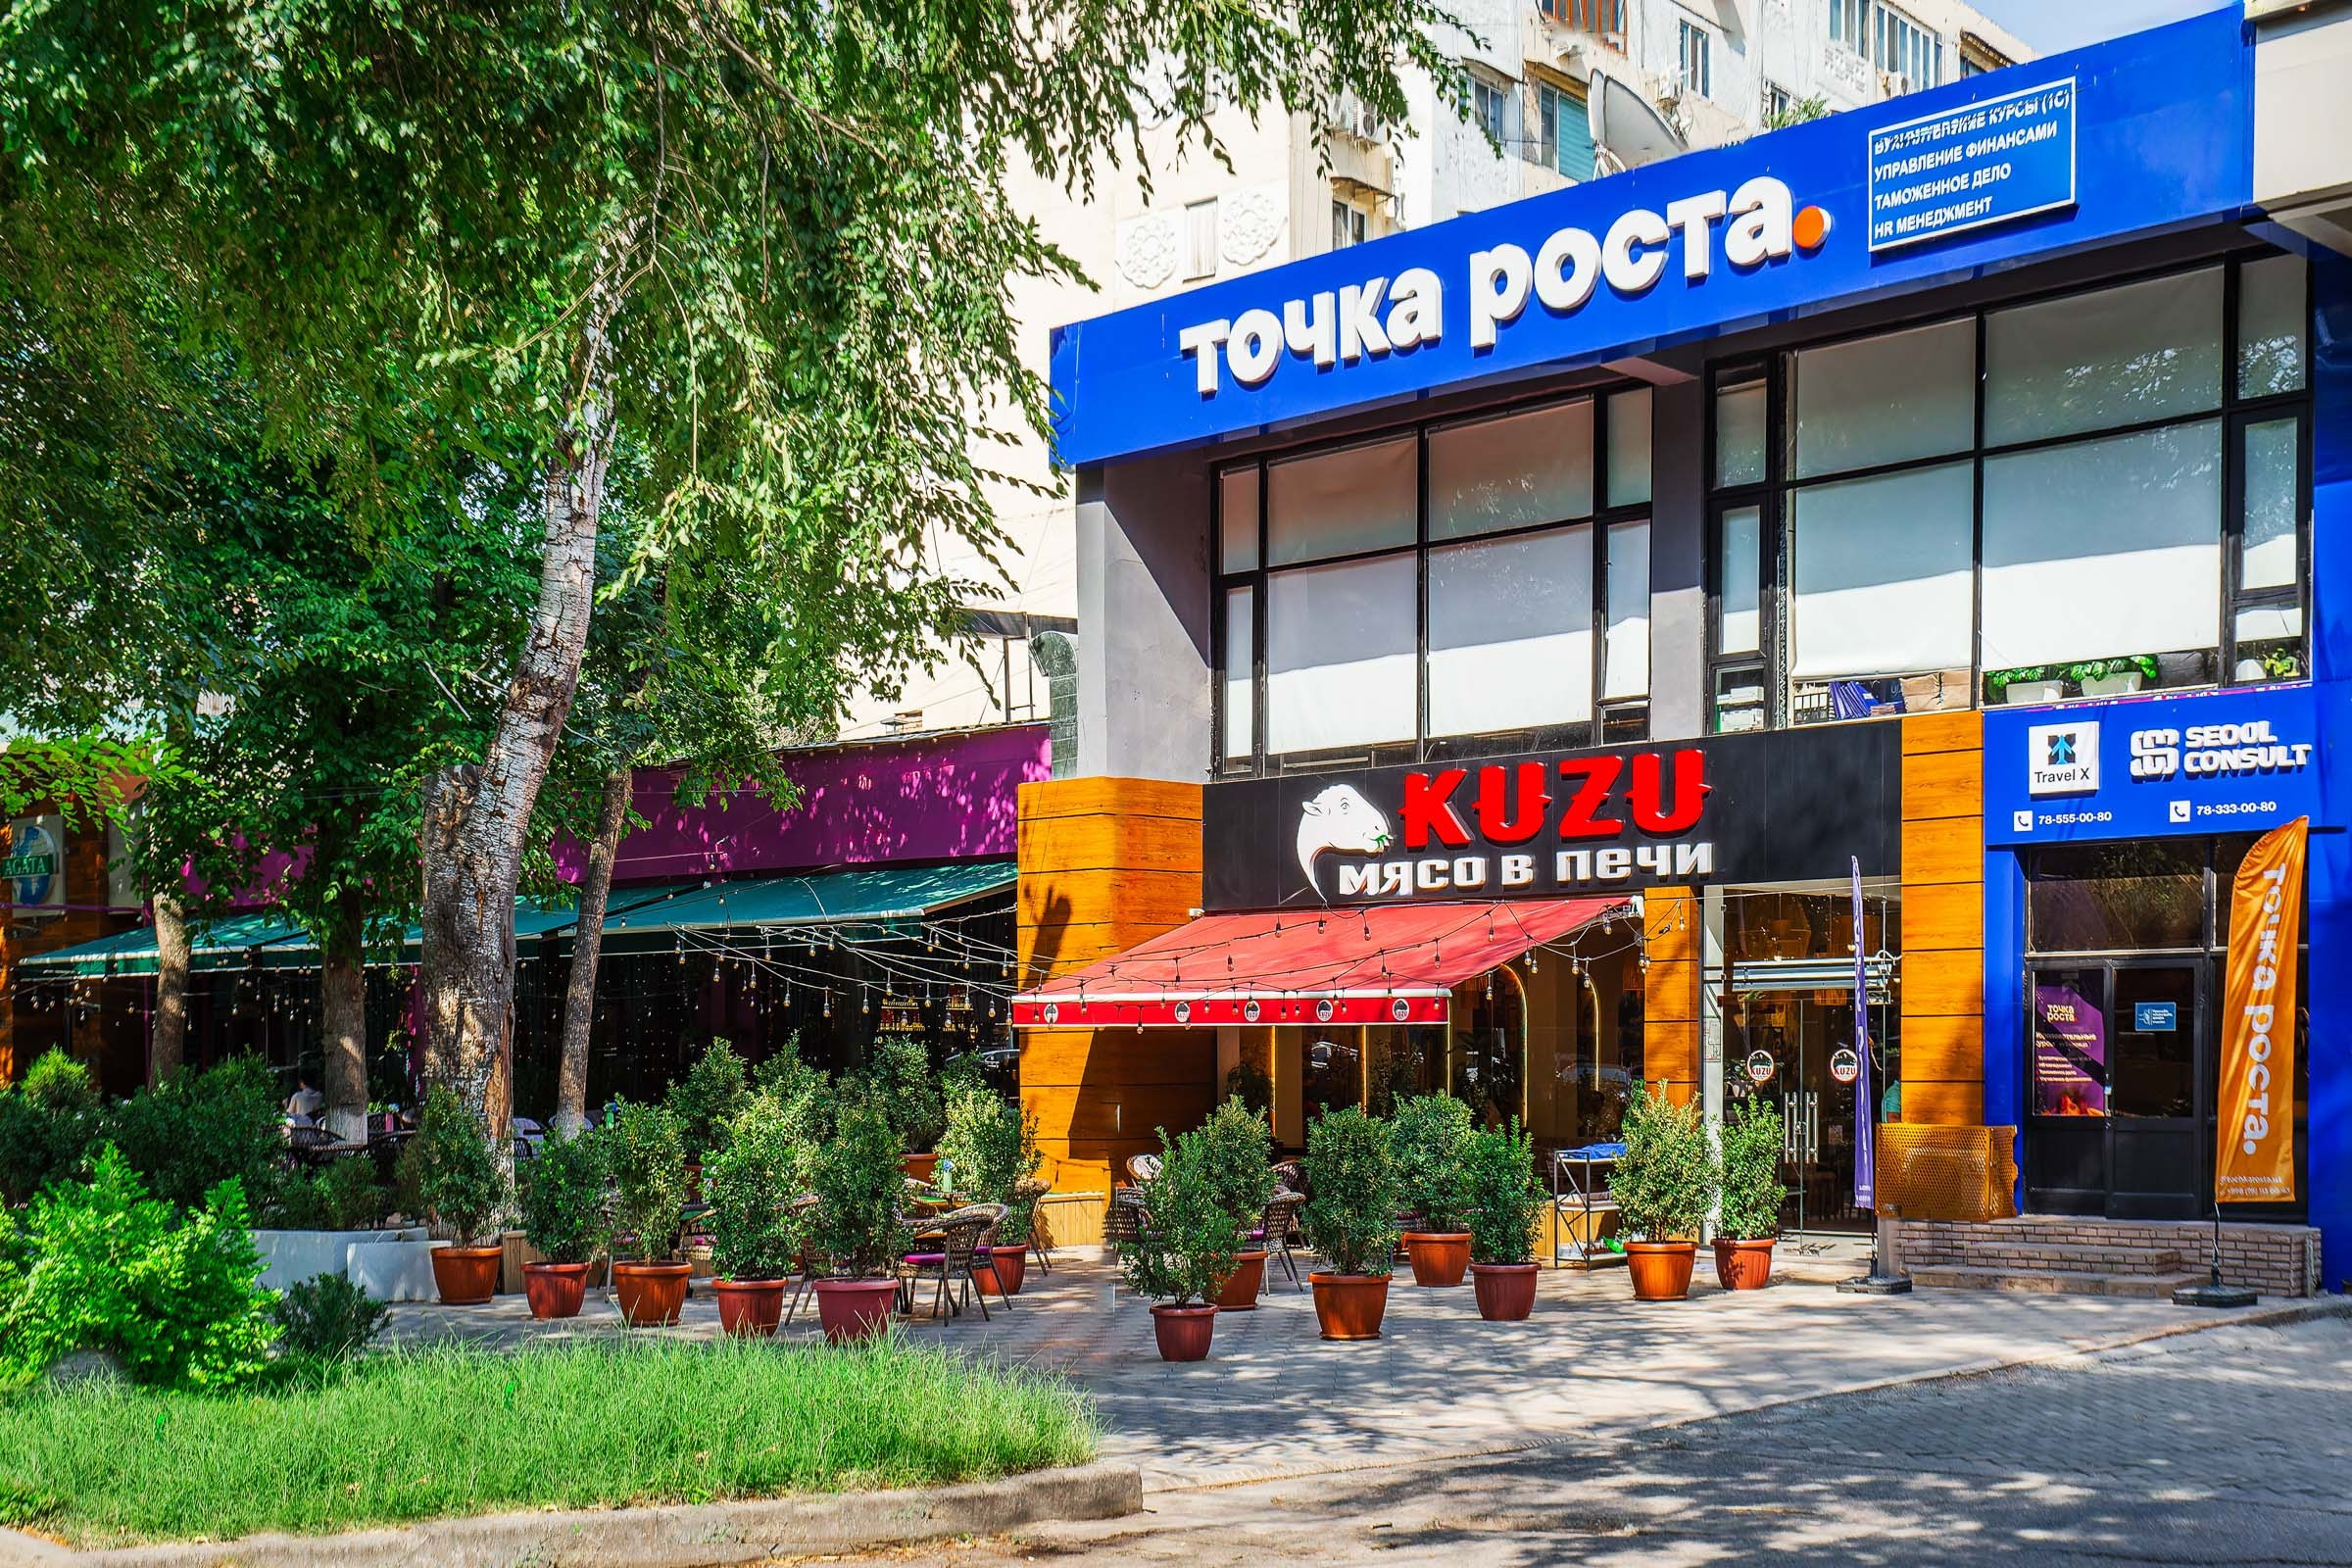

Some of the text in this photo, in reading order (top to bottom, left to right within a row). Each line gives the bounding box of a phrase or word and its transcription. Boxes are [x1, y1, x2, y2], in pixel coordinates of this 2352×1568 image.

[1988, 96, 2038, 124] КУРСЫ
[1874, 120, 2058, 182] УПРАВЛЕНИЕ ФИНАНСАМИ
[1874, 162, 2012, 212] ТАМОЖЕННОЕ ДЕЛО
[1874, 196, 1992, 240] HR МЕНЕДЖМЕНТ
[1180, 268, 1444, 394] точка
[2034, 767, 2089, 784] Travel X
[2183, 743, 2313, 773] CONSULT
[1397, 749, 1713, 850] KUZU
[2196, 801, 2277, 816] 78-333-00-80
[2037, 810, 2113, 825] 78-555-00-80
[4, 857, 46, 875] AGATA
[1556, 842, 1714, 883] печи
